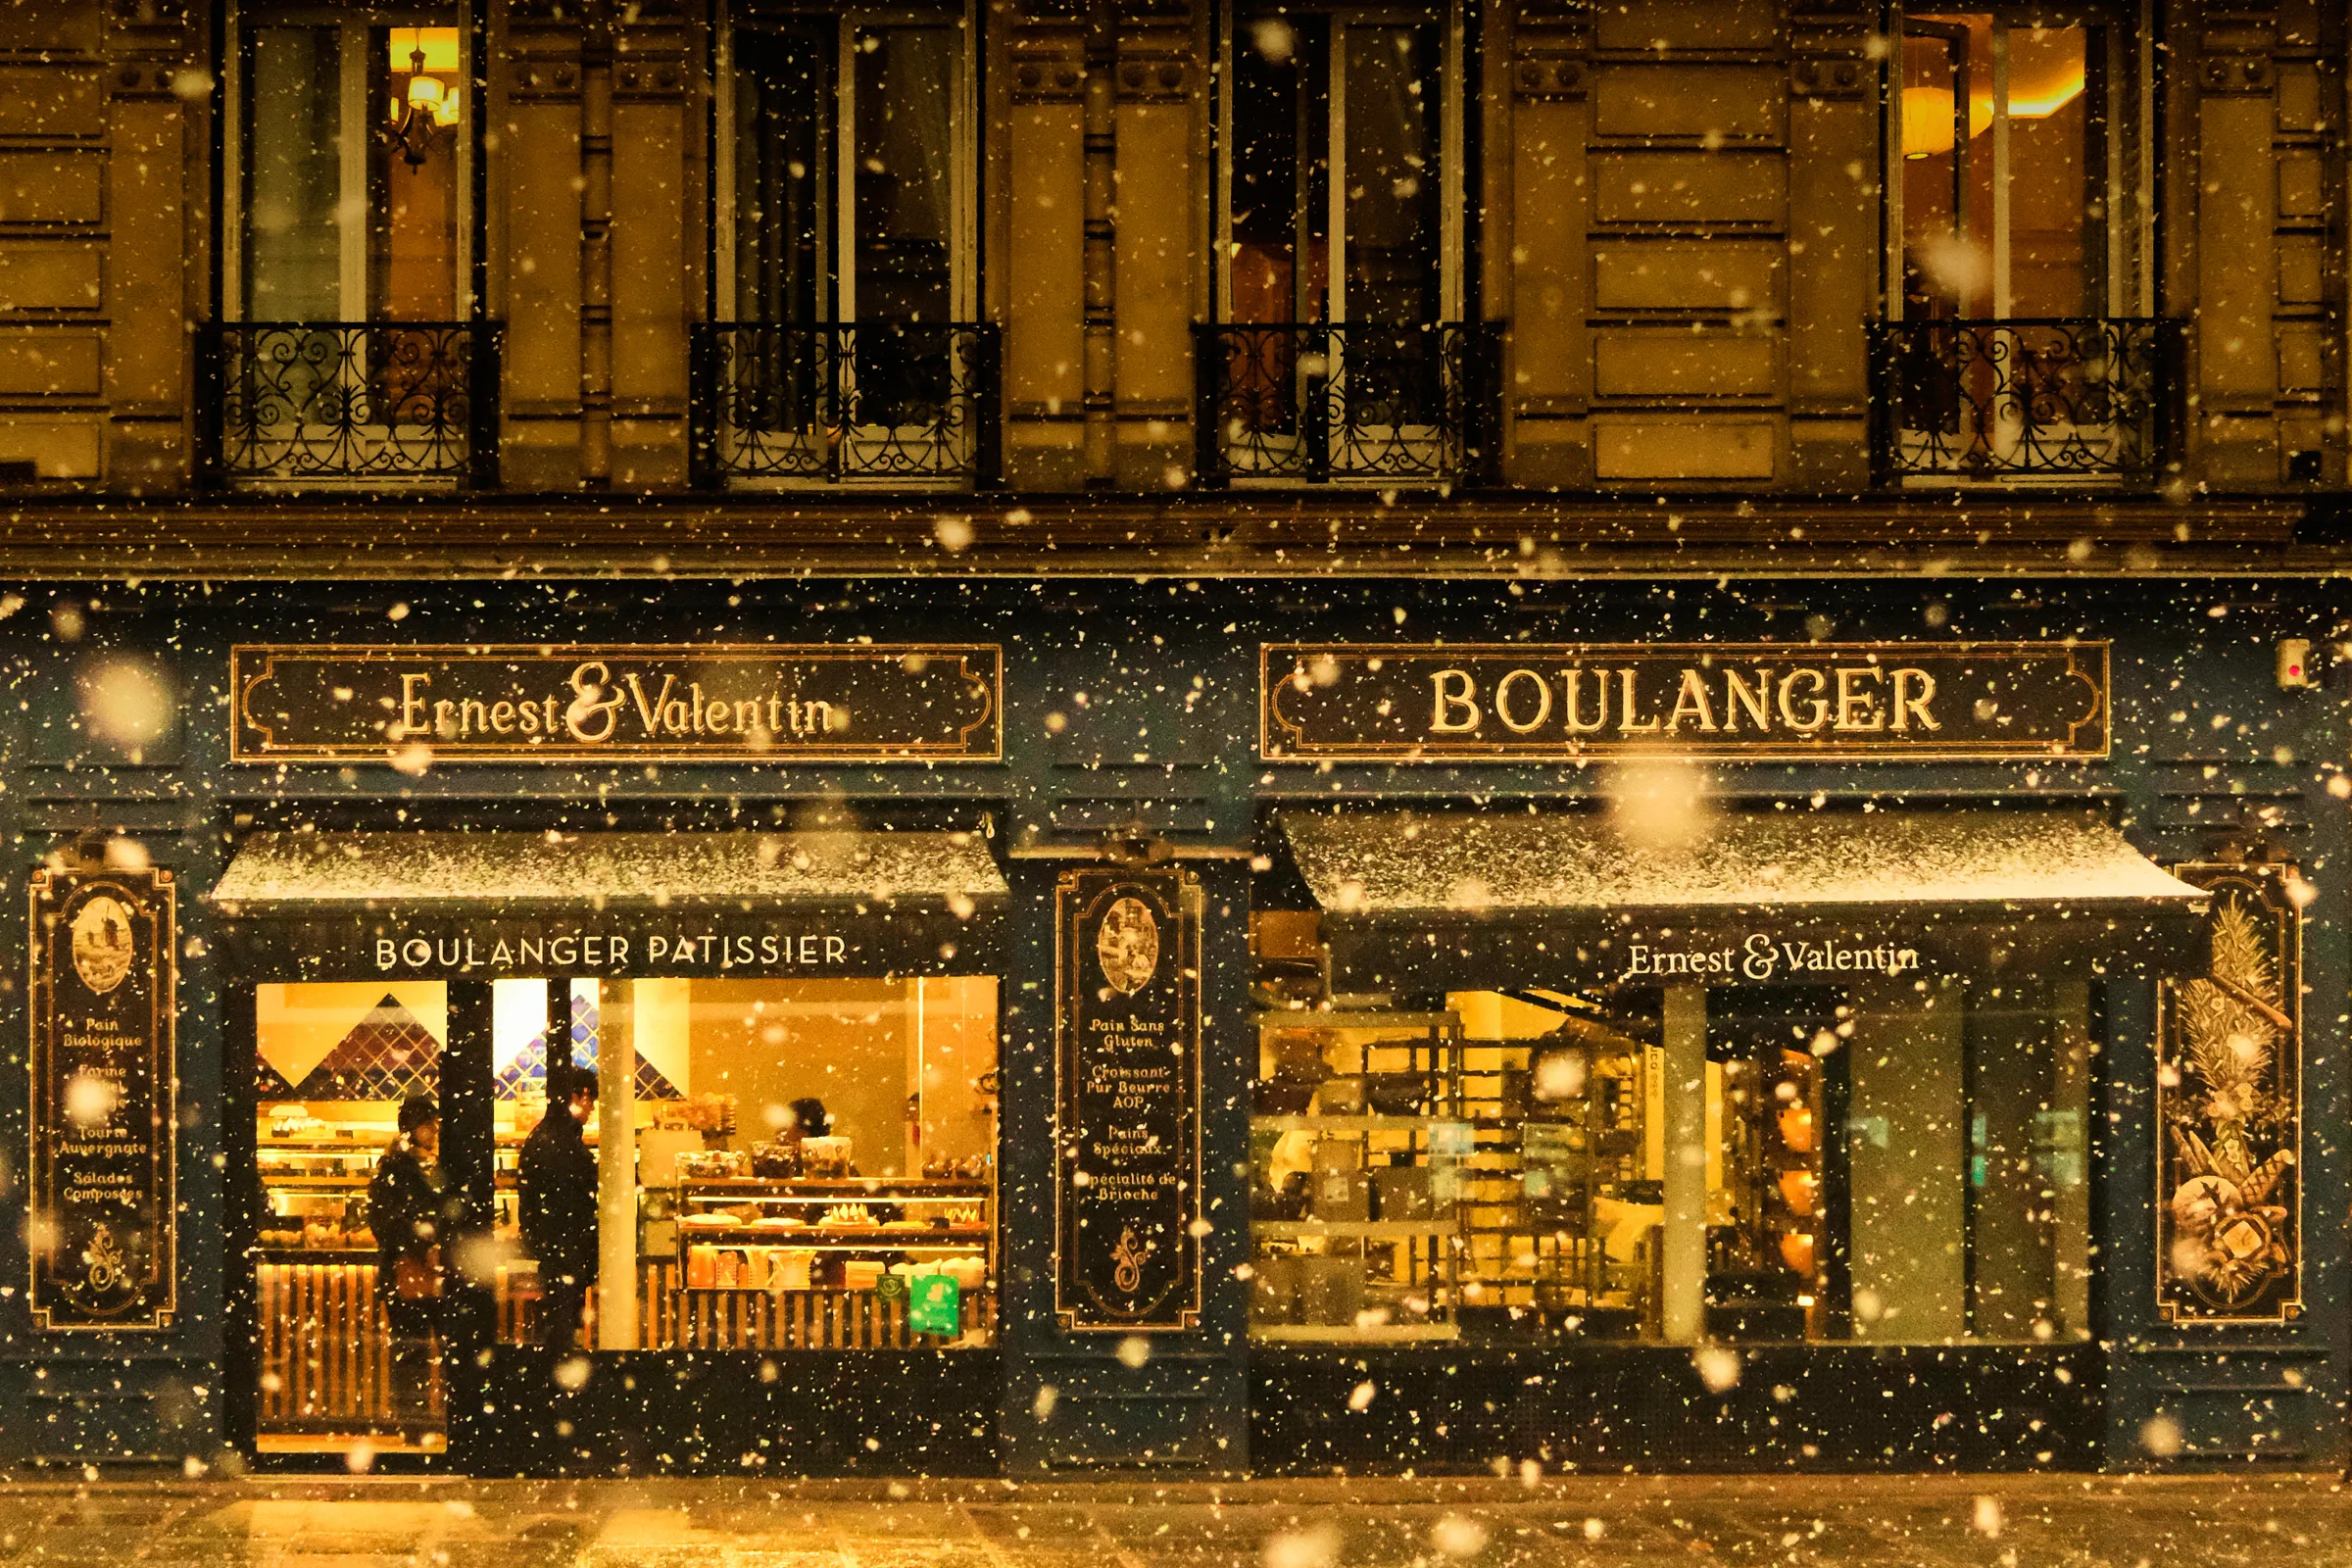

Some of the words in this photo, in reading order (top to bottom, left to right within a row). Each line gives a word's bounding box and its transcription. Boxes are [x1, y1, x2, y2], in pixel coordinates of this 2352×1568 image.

[400, 672, 560, 735] Ernest
[565, 662, 627, 743] &
[624, 673, 835, 735] Valentin
[1428, 667, 1942, 733] BOULANGER
[375, 937, 629, 967] BOULANGER
[649, 936, 848, 965] PATISSIER
[1628, 944, 1735, 974] Ernest
[1742, 934, 1780, 980] &
[1782, 939, 1920, 971] Valentin
[86, 1017, 119, 1031] Pain
[1091, 1018, 1126, 1032] Pain
[1130, 1018, 1165, 1032] Sans
[63, 1033, 142, 1052] Biologique
[1103, 1034, 1153, 1054] Gluten
[78, 1064, 126, 1078] Farine
[1092, 1064, 1164, 1079] Croissant
[1087, 1080, 1112, 1094] Pur
[1118, 1080, 1171, 1094] Beurre
[1112, 1096, 1145, 1109] AOP
[1108, 1124, 1149, 1140] Pains
[59, 1141, 146, 1158] Auvergnate
[74, 1171, 133, 1185] Salades
[1081, 1172, 1155, 1190] pécialité
[1158, 1173, 1176, 1185] de
[1099, 1188, 1159, 1200] Brioche
